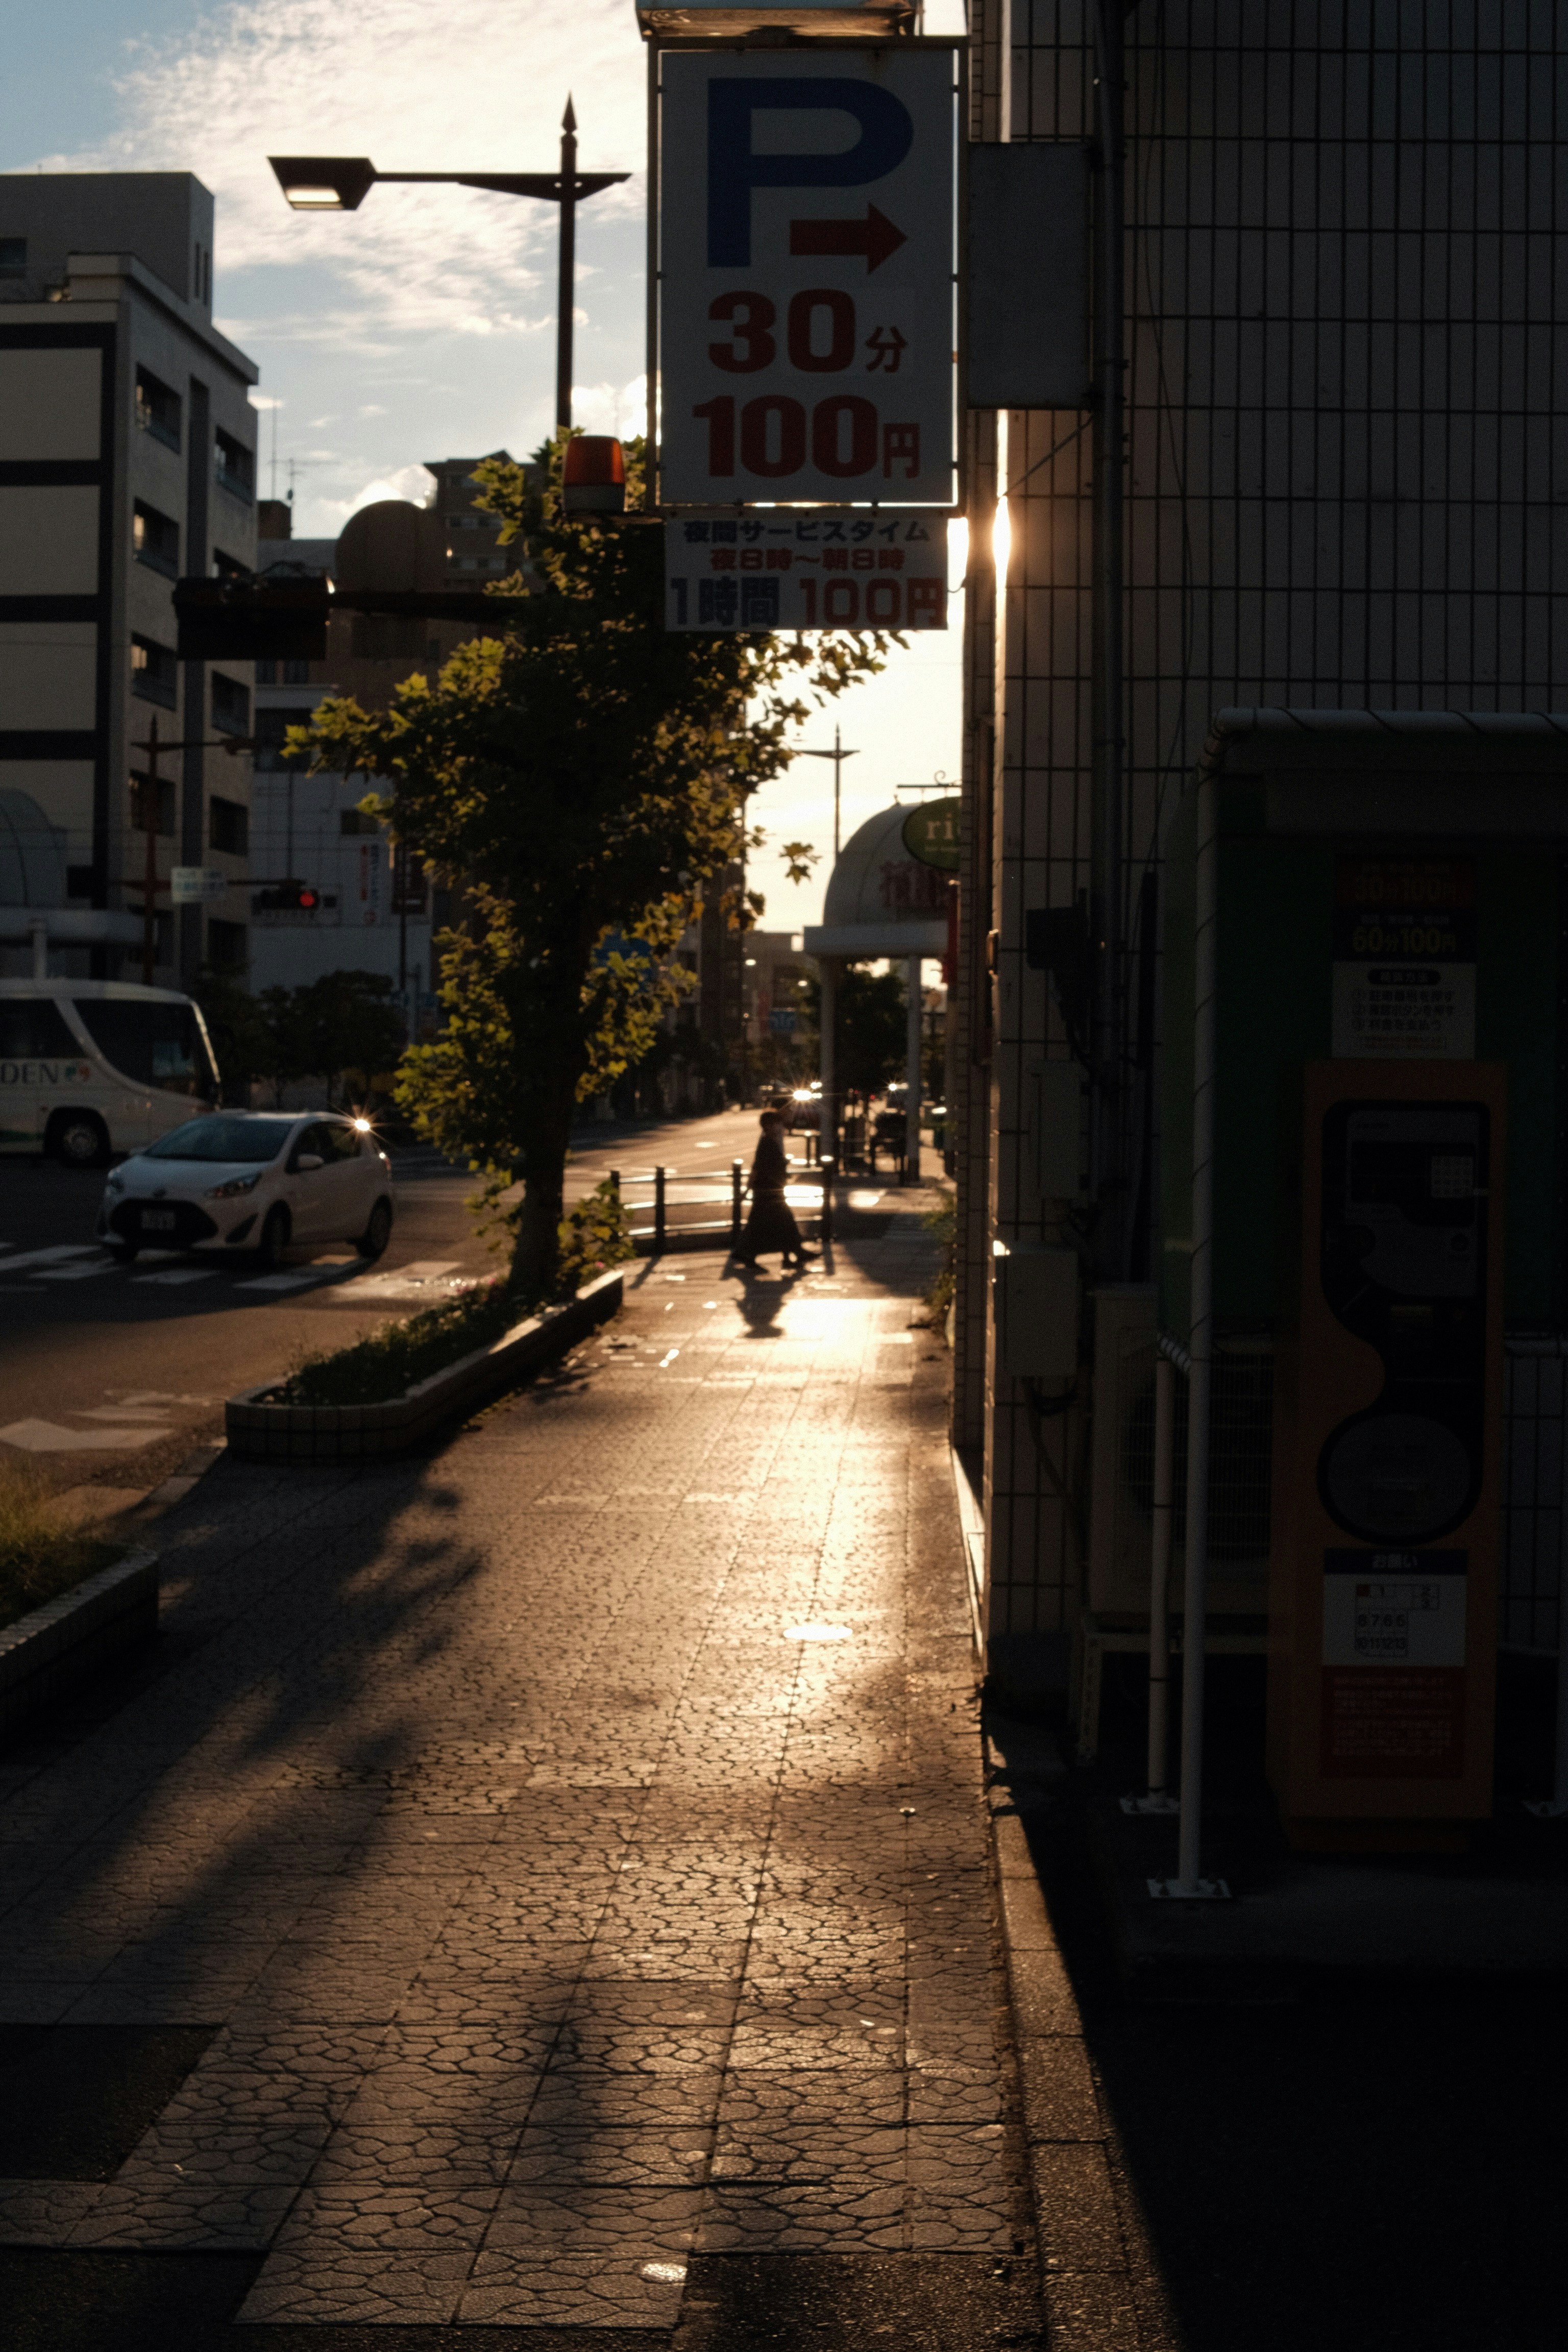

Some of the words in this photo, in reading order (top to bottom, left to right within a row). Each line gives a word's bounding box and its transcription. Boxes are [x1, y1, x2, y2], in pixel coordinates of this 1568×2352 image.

[707, 78, 913, 267] P
[708, 288, 907, 373] 30分
[693, 395, 919, 479] 100円
[684, 520, 929, 542] 夜間サービスタイム
[671, 576, 779, 626] 1時間
[799, 577, 944, 626] 100円
[925, 812, 961, 840] ri
[1, 1063, 59, 1084] DEN
[1371, 1614, 1379, 1627] 7
[1383, 1614, 1393, 1627] 6
